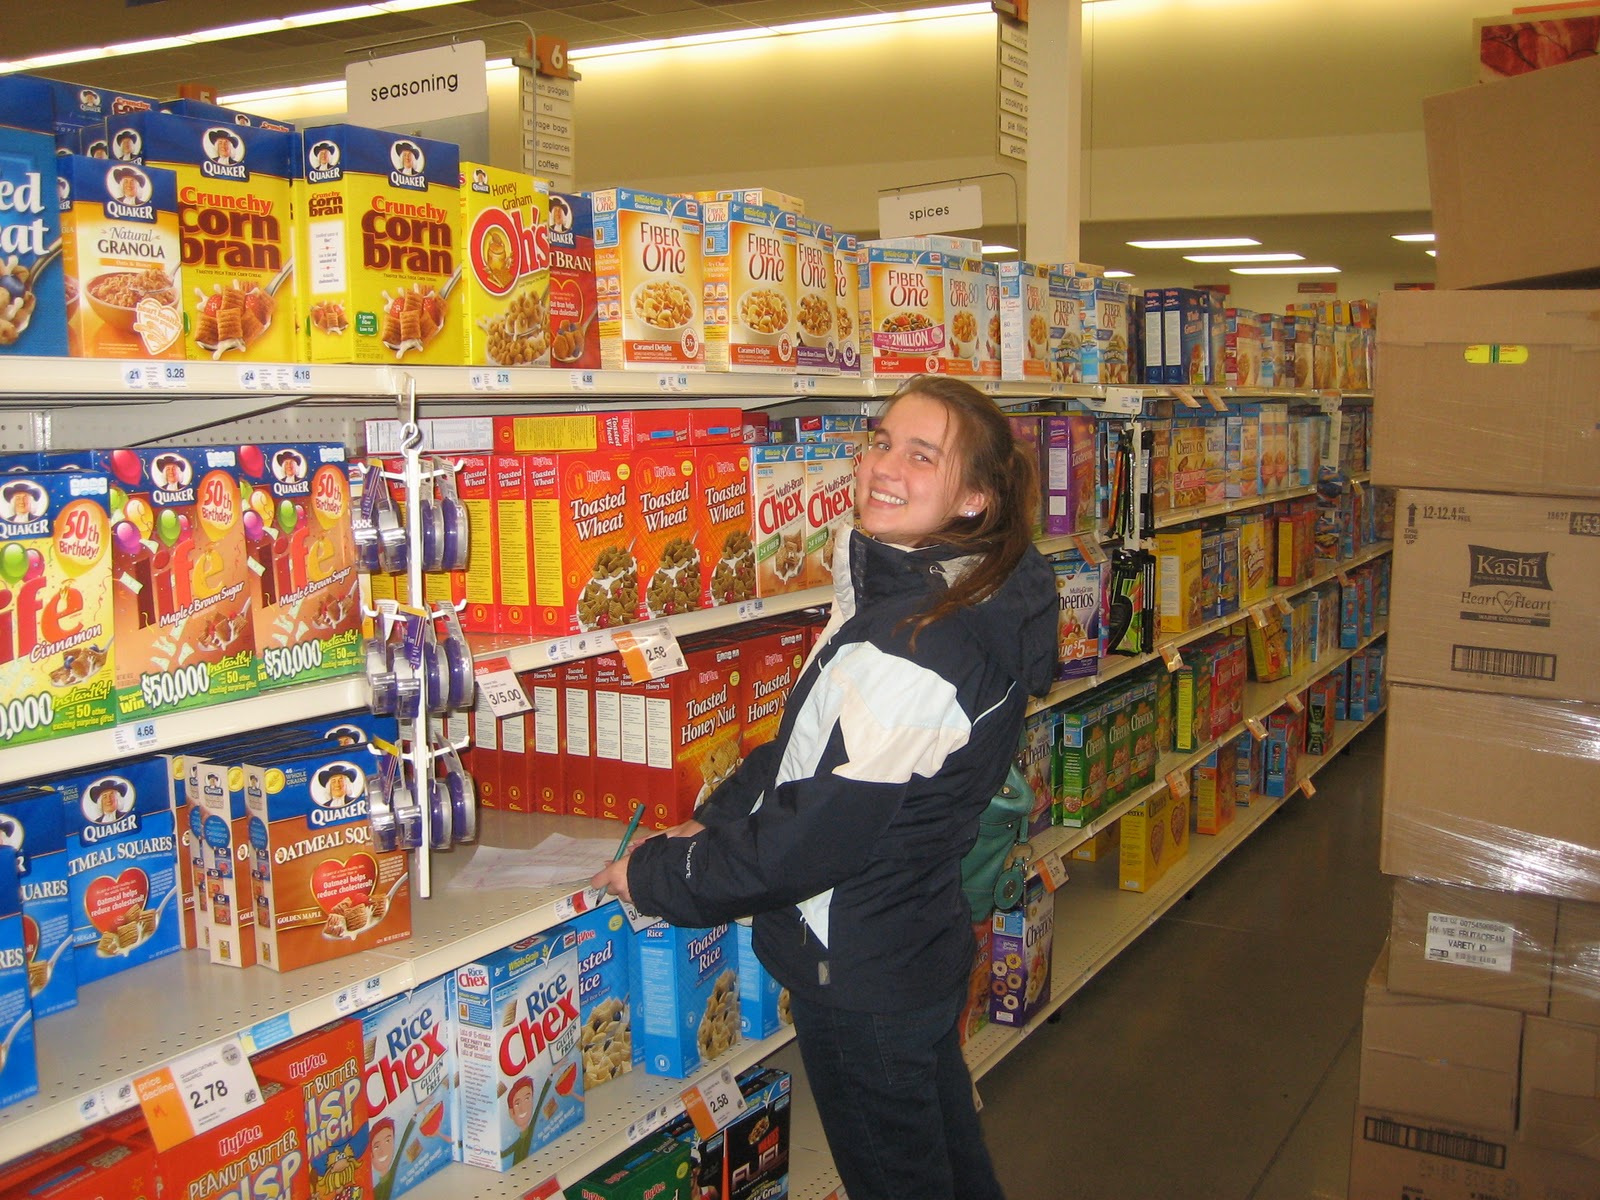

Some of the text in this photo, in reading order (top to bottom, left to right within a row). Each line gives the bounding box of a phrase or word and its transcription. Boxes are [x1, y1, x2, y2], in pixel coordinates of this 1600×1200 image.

[551, 44, 564, 70] 6
[371, 73, 459, 102] seasoning
[547, 85, 569, 97] gadgets
[1005, 97, 1023, 112] cooking
[552, 123, 568, 134] bags
[542, 141, 570, 153] appliances
[203, 163, 247, 179] QUAKER
[309, 167, 340, 183] QUAKER
[538, 160, 559, 170] coffee
[391, 171, 425, 188] QUAKER
[492, 182, 517, 197] Honey
[107, 202, 154, 220] QUAKER
[180, 186, 273, 217] Crunchy
[371, 195, 447, 224] Crunchy
[502, 193, 532, 211] Graham
[909, 204, 950, 221] spices
[110, 227, 153, 242] Natural
[640, 222, 682, 248] FIBER
[97, 239, 166, 259] GRANOLA
[181, 225, 282, 273] bran
[362, 231, 453, 275] bran
[748, 233, 782, 258] FIBER
[799, 243, 824, 266] FIBER
[555, 250, 592, 273] BRAN
[643, 242, 686, 274] One
[748, 254, 785, 283] One
[800, 261, 827, 289] One
[888, 270, 924, 288] FIBER
[950, 278, 967, 294] FIBER
[889, 285, 929, 307] One
[950, 283, 979, 307] One 80
[1055, 300, 1075, 315] FIBER
[1104, 303, 1122, 318] FIBER
[1053, 312, 1070, 327] ONE
[1103, 314, 1117, 329] ONE
[166, 368, 185, 379] 3.28
[294, 370, 311, 380] 4.18
[463, 470, 487, 480] Toasted
[465, 478, 486, 487] Wheat
[497, 469, 522, 480] Toasted
[499, 477, 521, 488] Wheat
[531, 468, 556, 480] Toasted
[533, 477, 555, 487] Wheat
[824, 473, 853, 495] Multi-Bran
[153, 488, 195, 505] QUAKER
[203, 480, 233, 510] 50th
[273, 482, 310, 497] QUAKER
[317, 474, 342, 501] 50th
[640, 481, 690, 513] Toasted
[705, 476, 747, 507] Toasted
[775, 476, 805, 499] Multi-Bran
[316, 498, 342, 515] Birthday!
[570, 486, 627, 520] Toasted
[709, 500, 745, 525] Wheat
[758, 488, 805, 535] Chex
[807, 485, 853, 529] Chex
[1423, 505, 1457, 521] 12-12.4
[202, 508, 233, 524] Birthday!
[645, 506, 688, 533] Wheat
[0, 519, 49, 539] QUAKER
[62, 510, 100, 544] 50th
[575, 512, 625, 541] Wheat
[59, 541, 99, 560] Birthday!
[1476, 553, 1539, 580] Kashi
[280, 566, 351, 607] Maple Brown Sugar
[160, 582, 245, 628] Maple Brown Sugar
[1058, 592, 1094, 611] heerios
[1461, 591, 1551, 611] Heart to Heart
[1500, 616, 1532, 625] CINNAMON
[30, 623, 102, 663] Cinnamon
[336, 647, 347, 658] 50
[264, 629, 359, 681] $50,000 Instantly!
[226, 671, 238, 684] 50
[475, 666, 489, 677] sale
[120, 651, 253, 714] Win $50,000 Instantly!
[753, 667, 791, 700] Toasted
[51, 680, 113, 711] Instantly!
[489, 688, 522, 706] 3/5.00
[686, 683, 727, 720] Toasted
[76, 704, 91, 717] 50
[747, 700, 779, 723] Honey
[137, 725, 155, 737] 4.68
[681, 704, 736, 746] Honey Nut
[286, 771, 307, 780] WHOLE
[286, 777, 308, 786] GRAINS
[311, 800, 368, 826] QUAKER
[83, 815, 138, 842] QUAKER
[118, 836, 173, 865] SQUARES
[275, 830, 345, 865] OATMEAL
[317, 880, 373, 899] reduce cholesterol!
[323, 874, 366, 889] Oatmeal helps
[277, 911, 322, 925] GOLDEN MAPLE
[647, 929, 663, 938] Rice
[687, 920, 728, 962] Toasted
[1429, 926, 1455, 937] HY VEE
[1448, 939, 1476, 951] VARIETY
[698, 945, 721, 974] Rice
[459, 973, 488, 988] Chex
[467, 967, 484, 976] Rice
[367, 978, 381, 989] 4.38
[525, 972, 568, 1022] Rice
[386, 1006, 434, 1060] Rice
[499, 987, 579, 1077] Chex
[555, 1023, 578, 1052] GLUTEN
[561, 1036, 576, 1058] FREE
[314, 1057, 359, 1092] BUTTER
[365, 1021, 447, 1118] Chex
[420, 1058, 445, 1091] GLUTEN
[138, 1076, 161, 1091] price
[142, 1082, 176, 1101] decline
[425, 1075, 442, 1098] FREE
[83, 1098, 95, 1110] 26
[190, 1080, 228, 1109] 2.78
[710, 1094, 729, 1113] 2.58
[218, 1125, 263, 1158] HyVee
[188, 1127, 299, 1200] PEANUT BUTTER
